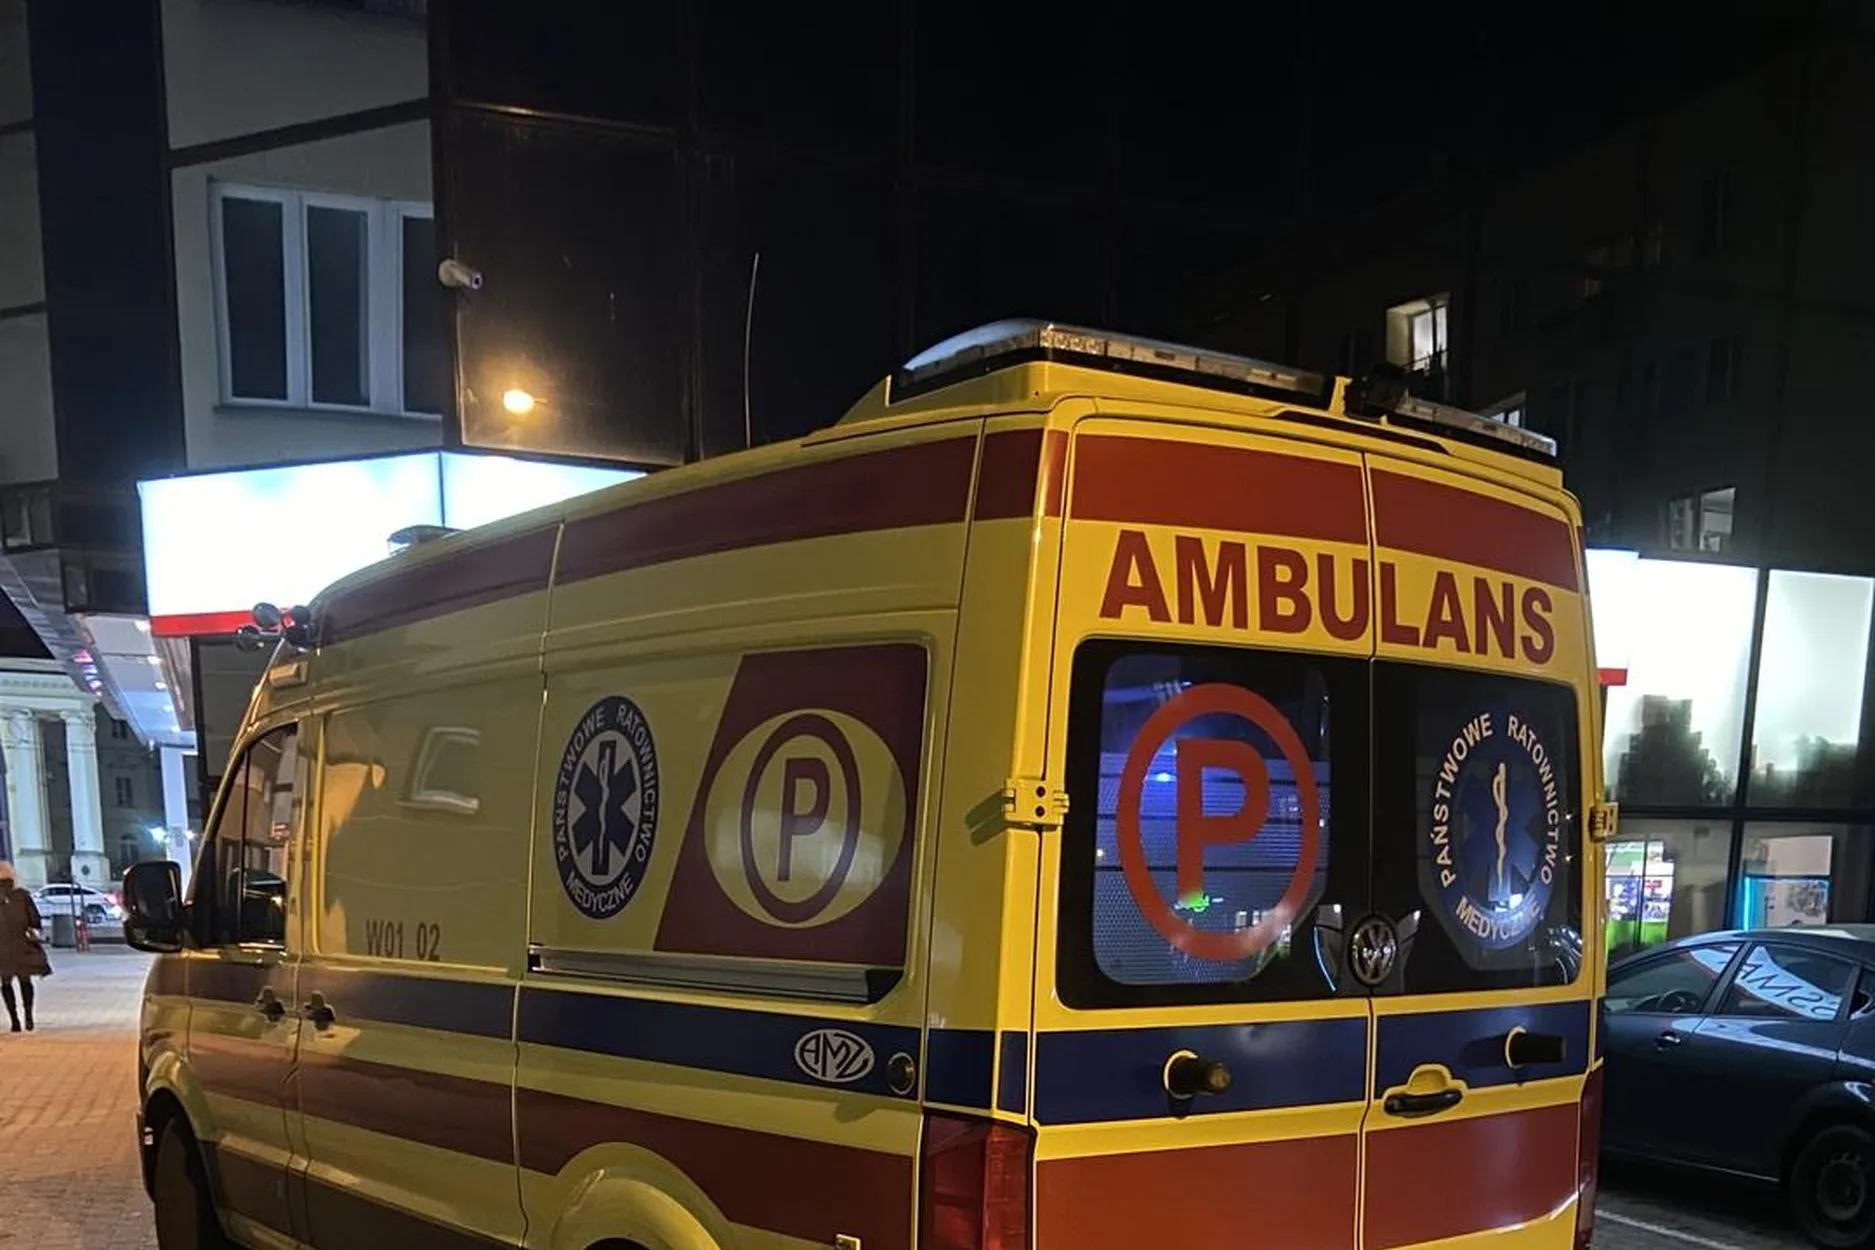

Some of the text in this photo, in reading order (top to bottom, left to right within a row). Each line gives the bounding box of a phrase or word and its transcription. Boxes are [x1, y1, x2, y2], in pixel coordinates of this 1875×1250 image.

[1099, 529, 1556, 665] AMBULANS
[616, 704, 656, 862] RATOWNICTWO
[778, 758, 830, 882] P
[1430, 713, 1559, 888] PAŃSTWOWE RATOWNICTWO
[366, 917, 440, 961] W01 02
[566, 870, 637, 913] MEDYCZNE
